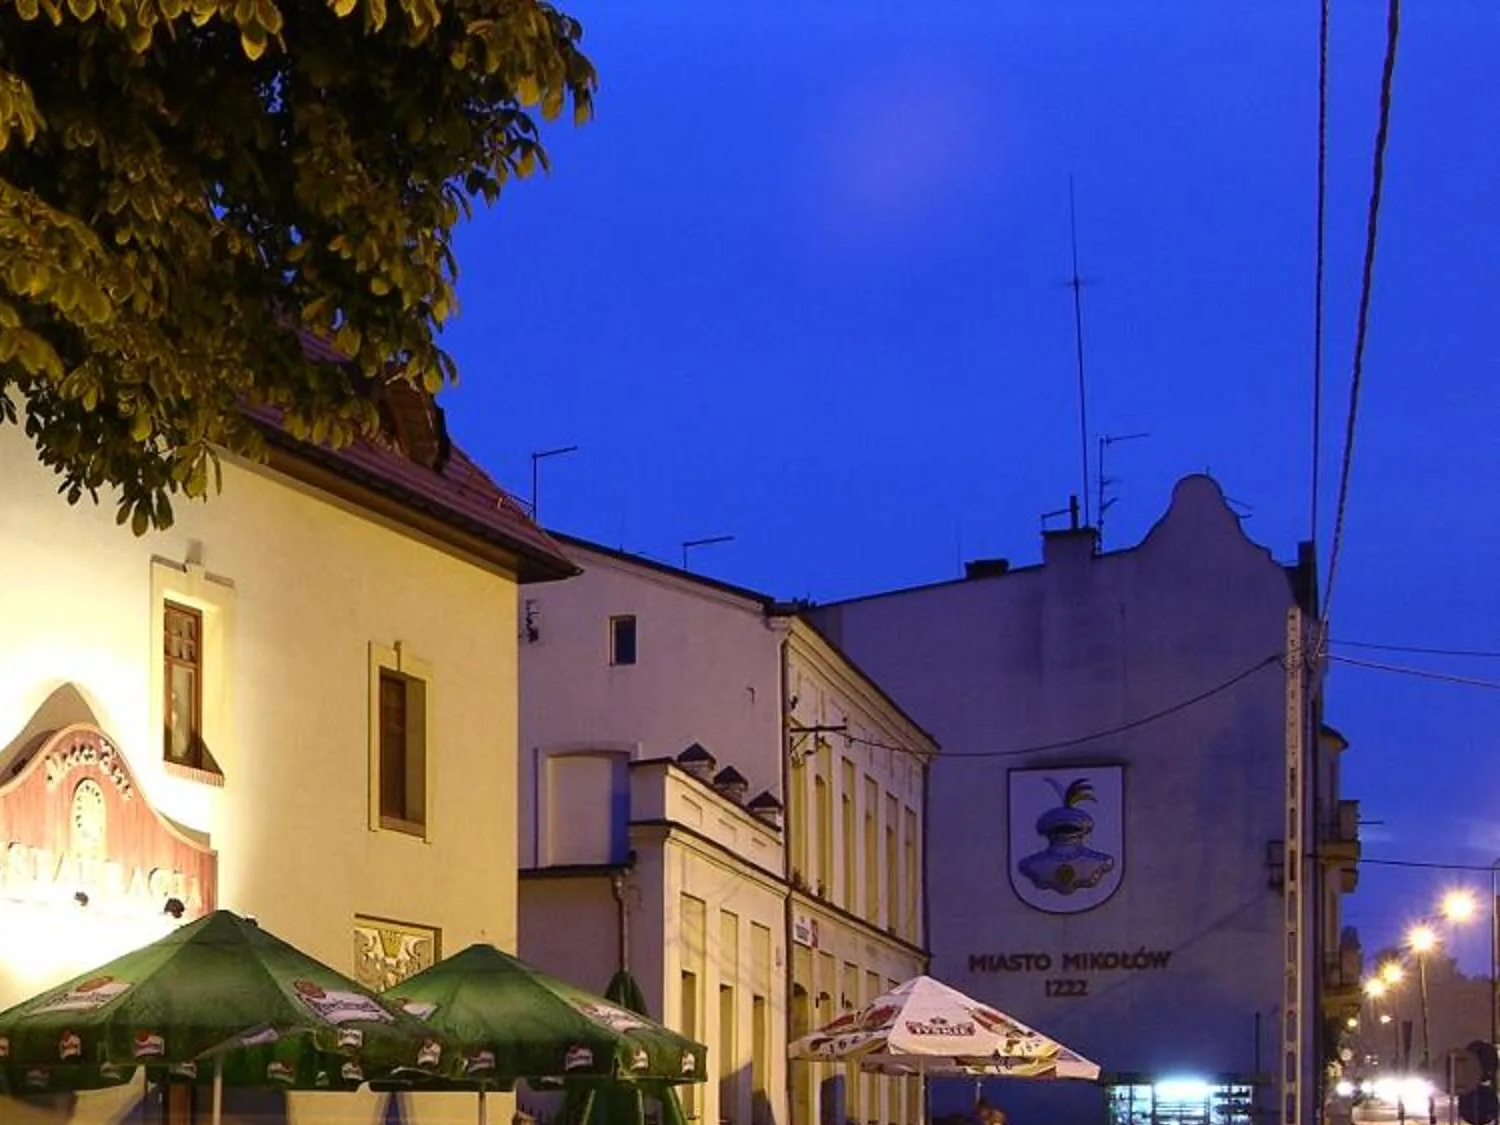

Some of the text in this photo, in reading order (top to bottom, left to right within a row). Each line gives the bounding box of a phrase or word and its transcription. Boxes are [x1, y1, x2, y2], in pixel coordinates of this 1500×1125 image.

[969, 946, 1172, 972] MIASTO MIKOŁÓW
[1045, 980, 1089, 996] 1222
